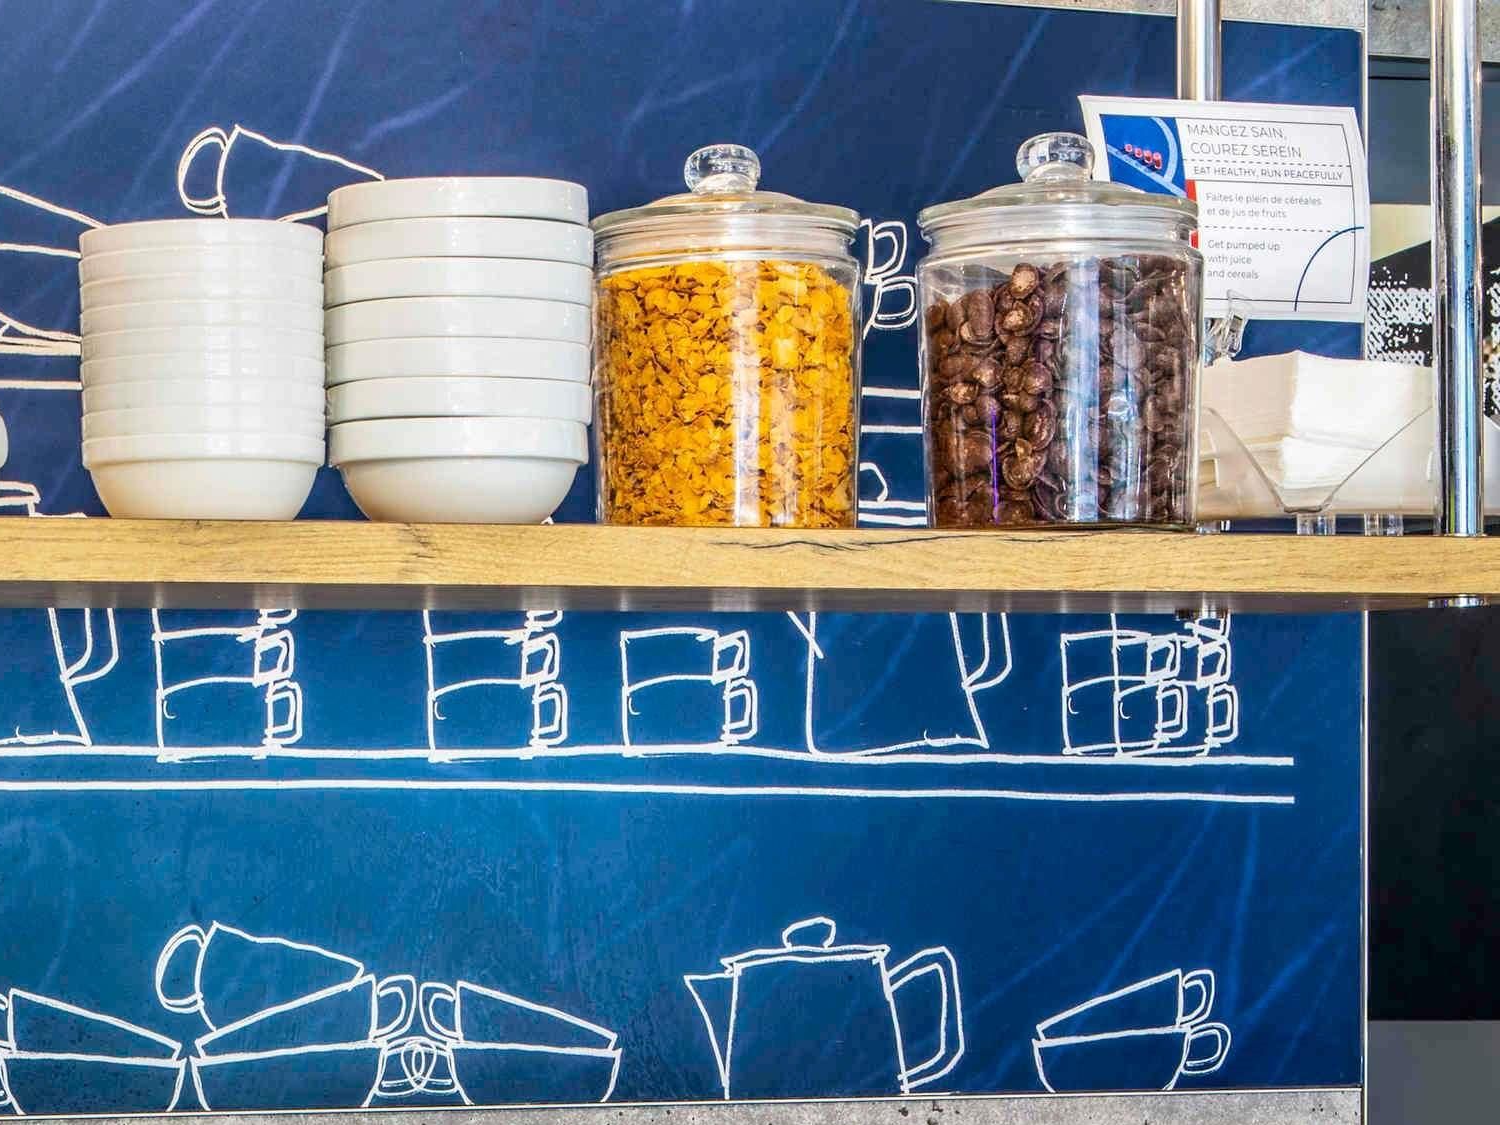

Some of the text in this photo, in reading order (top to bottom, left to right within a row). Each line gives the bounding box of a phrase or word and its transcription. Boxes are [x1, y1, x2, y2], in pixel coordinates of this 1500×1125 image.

[1187, 124, 1248, 138] MANGEZ
[1190, 142, 1249, 157] COUREZ
[1194, 166, 1210, 175] EAT
[1261, 168, 1281, 178] RUN
[1283, 169, 1343, 181] PEACEFULLY
[1206, 192, 1233, 202] Faites
[1235, 193, 1244, 202] le
[1246, 194, 1268, 205] plein
[1270, 195, 1282, 204] de
[1207, 208, 1287, 219] et de jus de fruits
[1207, 240, 1281, 252] Get pumped up
[1207, 255, 1252, 265] with juice
[1207, 269, 1259, 280] and cereals
